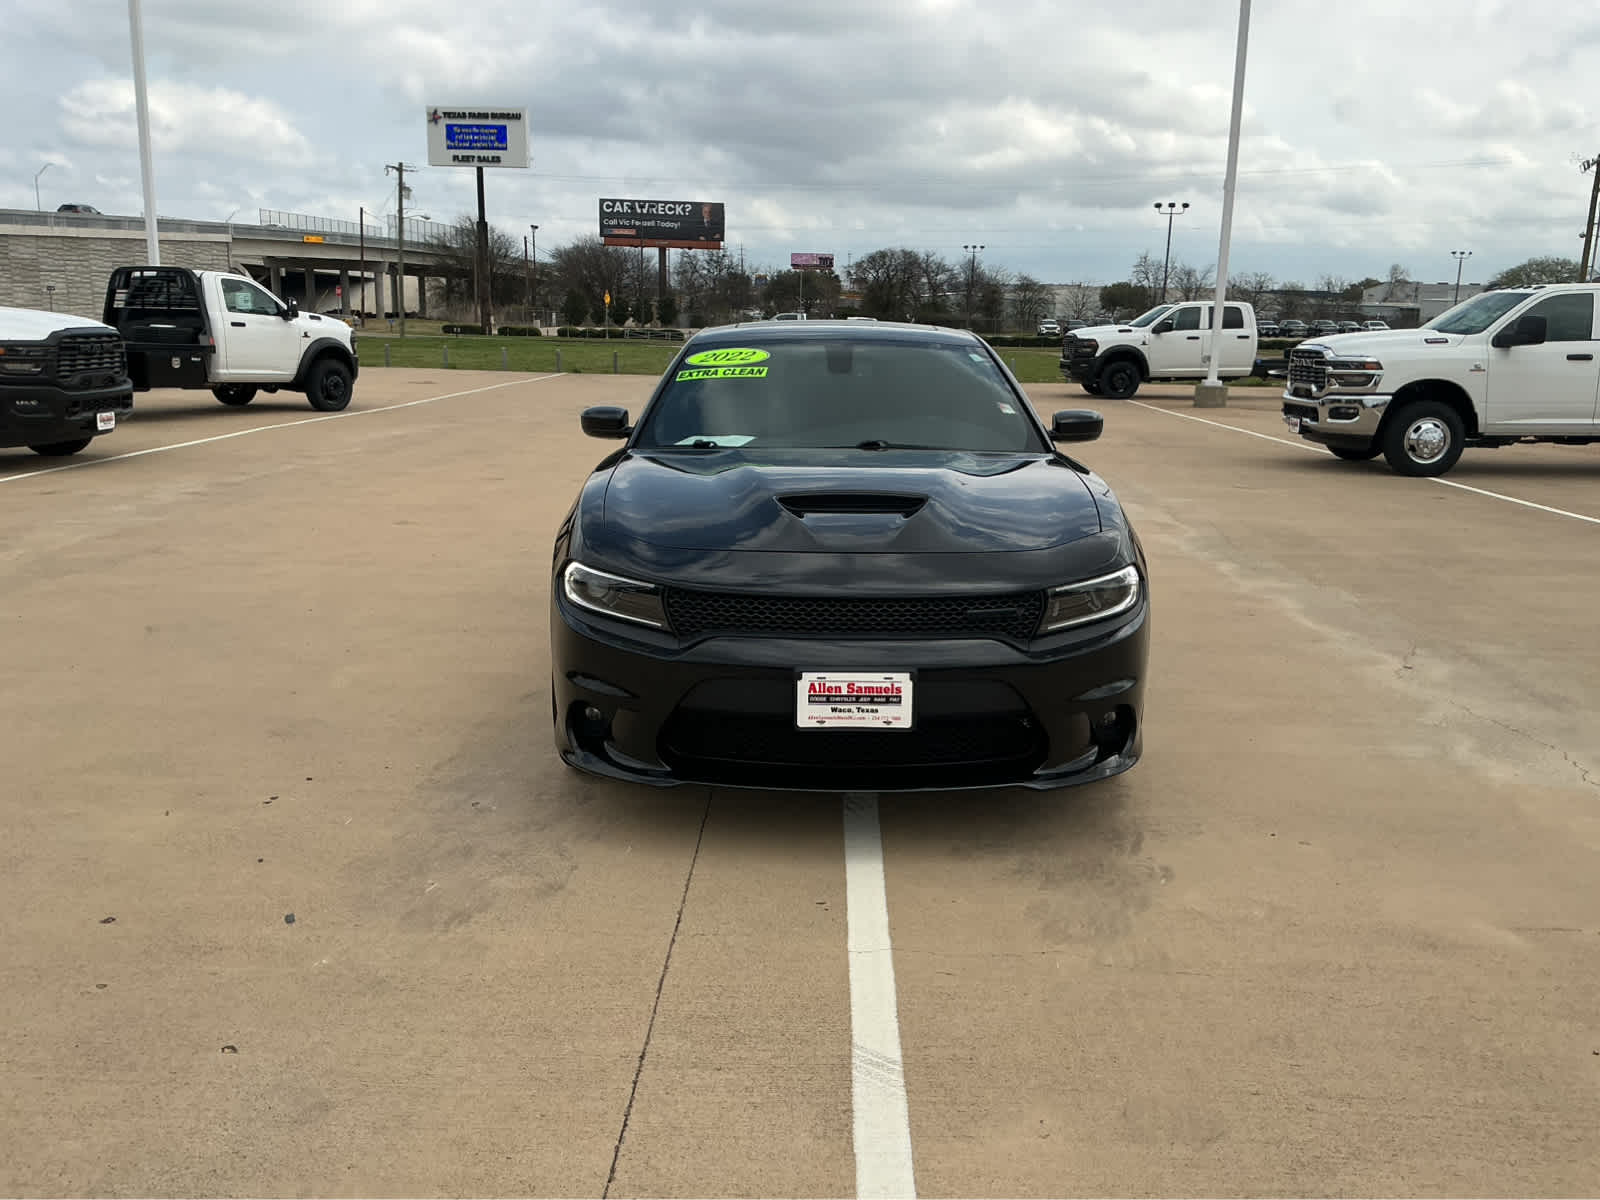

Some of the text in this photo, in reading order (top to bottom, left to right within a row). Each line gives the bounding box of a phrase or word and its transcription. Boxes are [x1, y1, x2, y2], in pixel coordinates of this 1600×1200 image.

[491, 112, 521, 120] BUREAU
[603, 201, 692, 216] CAR WRECK?
[620, 218, 631, 226] Vic
[657, 220, 680, 230] Today!
[699, 351, 756, 363] 2022
[679, 368, 764, 379] EXTRA CLEAN
[808, 682, 902, 694] Allen Samuels
